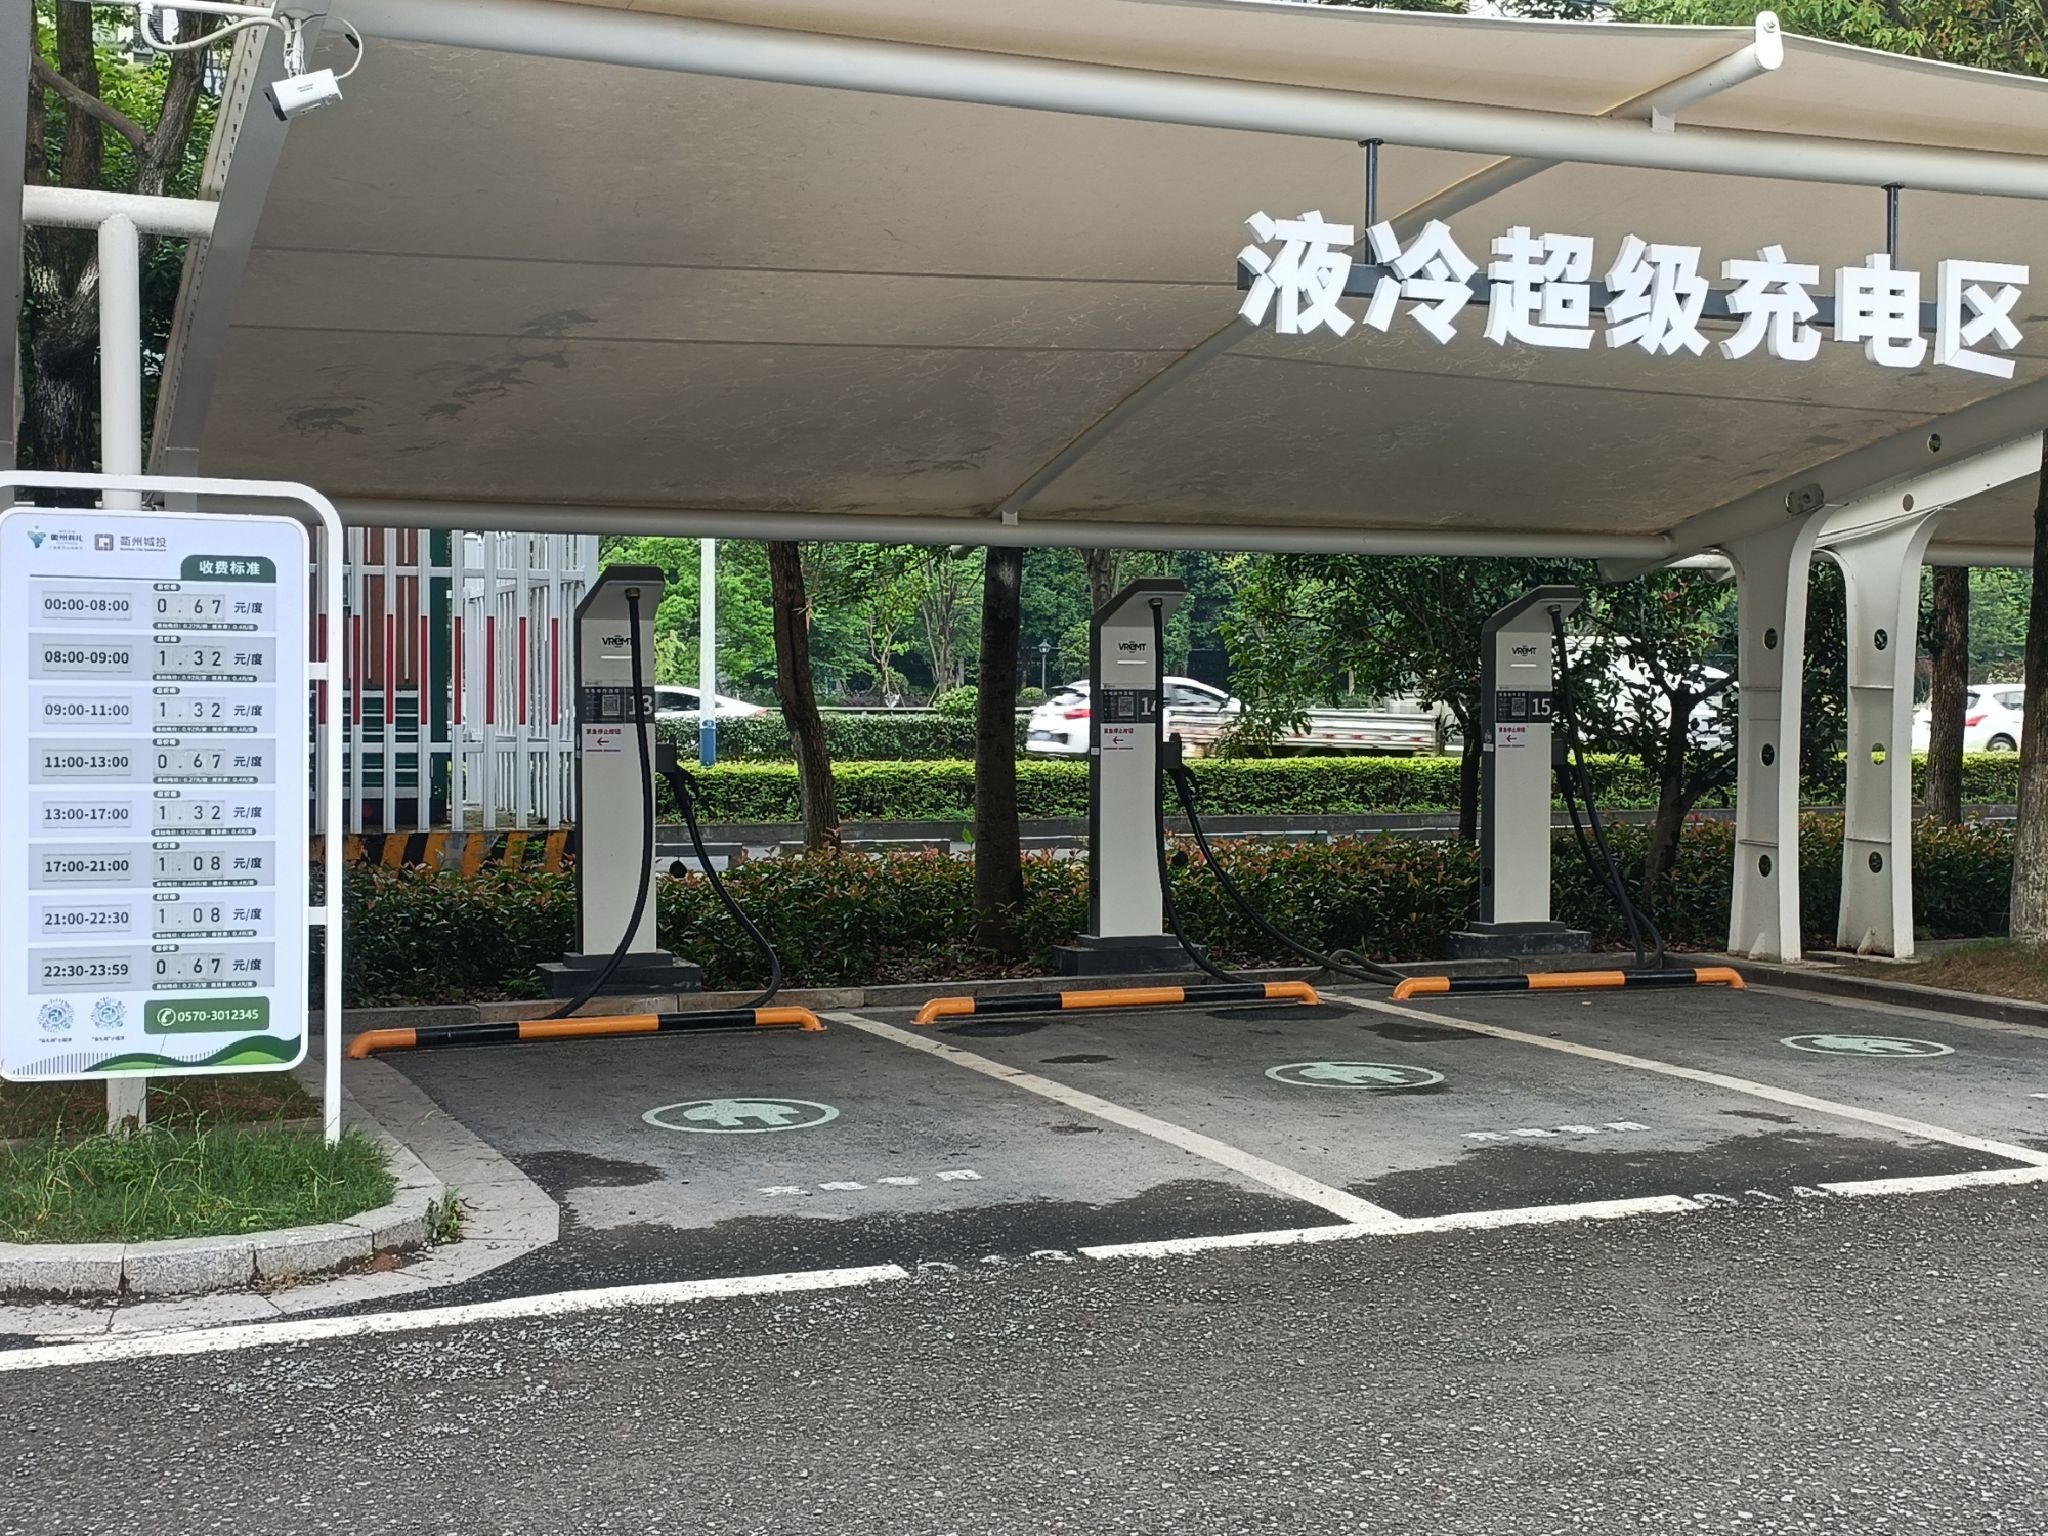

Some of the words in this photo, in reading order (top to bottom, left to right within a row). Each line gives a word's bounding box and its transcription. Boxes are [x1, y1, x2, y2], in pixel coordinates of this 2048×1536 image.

[1238, 209, 2031, 379] 液冷超级充电区
[199, 560, 261, 576] 收费标准
[44, 598, 130, 612] 00:00-08:00
[157, 598, 221, 614] 0.67
[233, 601, 263, 614] 元/度
[44, 650, 130, 664] 08:00-09:00
[159, 650, 222, 667] 1.32
[233, 653, 263, 666] 元/度
[45, 704, 130, 716] 09:00-11:00
[159, 702, 221, 718] 1.32
[233, 705, 263, 717] 元/度
[628, 694, 653, 716] 13
[1531, 698, 1551, 716] 15
[45, 756, 129, 768] 11:00-13:00
[157, 753, 221, 769] 0.67
[233, 756, 263, 768] 元/度
[45, 808, 129, 820] 13:00-17:00
[159, 805, 221, 820] 1.32
[233, 806, 263, 819] 元/度
[45, 860, 129, 873] 17:00-21:00
[159, 856, 221, 871] 1.08
[233, 857, 263, 870] 元/度
[44, 911, 129, 926] 21:00-22:30
[159, 907, 221, 924] 1.08
[232, 908, 263, 921] 元/度
[44, 964, 129, 978] 22:30-23:59
[156, 958, 221, 974] 0.67
[232, 958, 262, 972] 元/度
[177, 1009, 259, 1022] 0570-3012345
